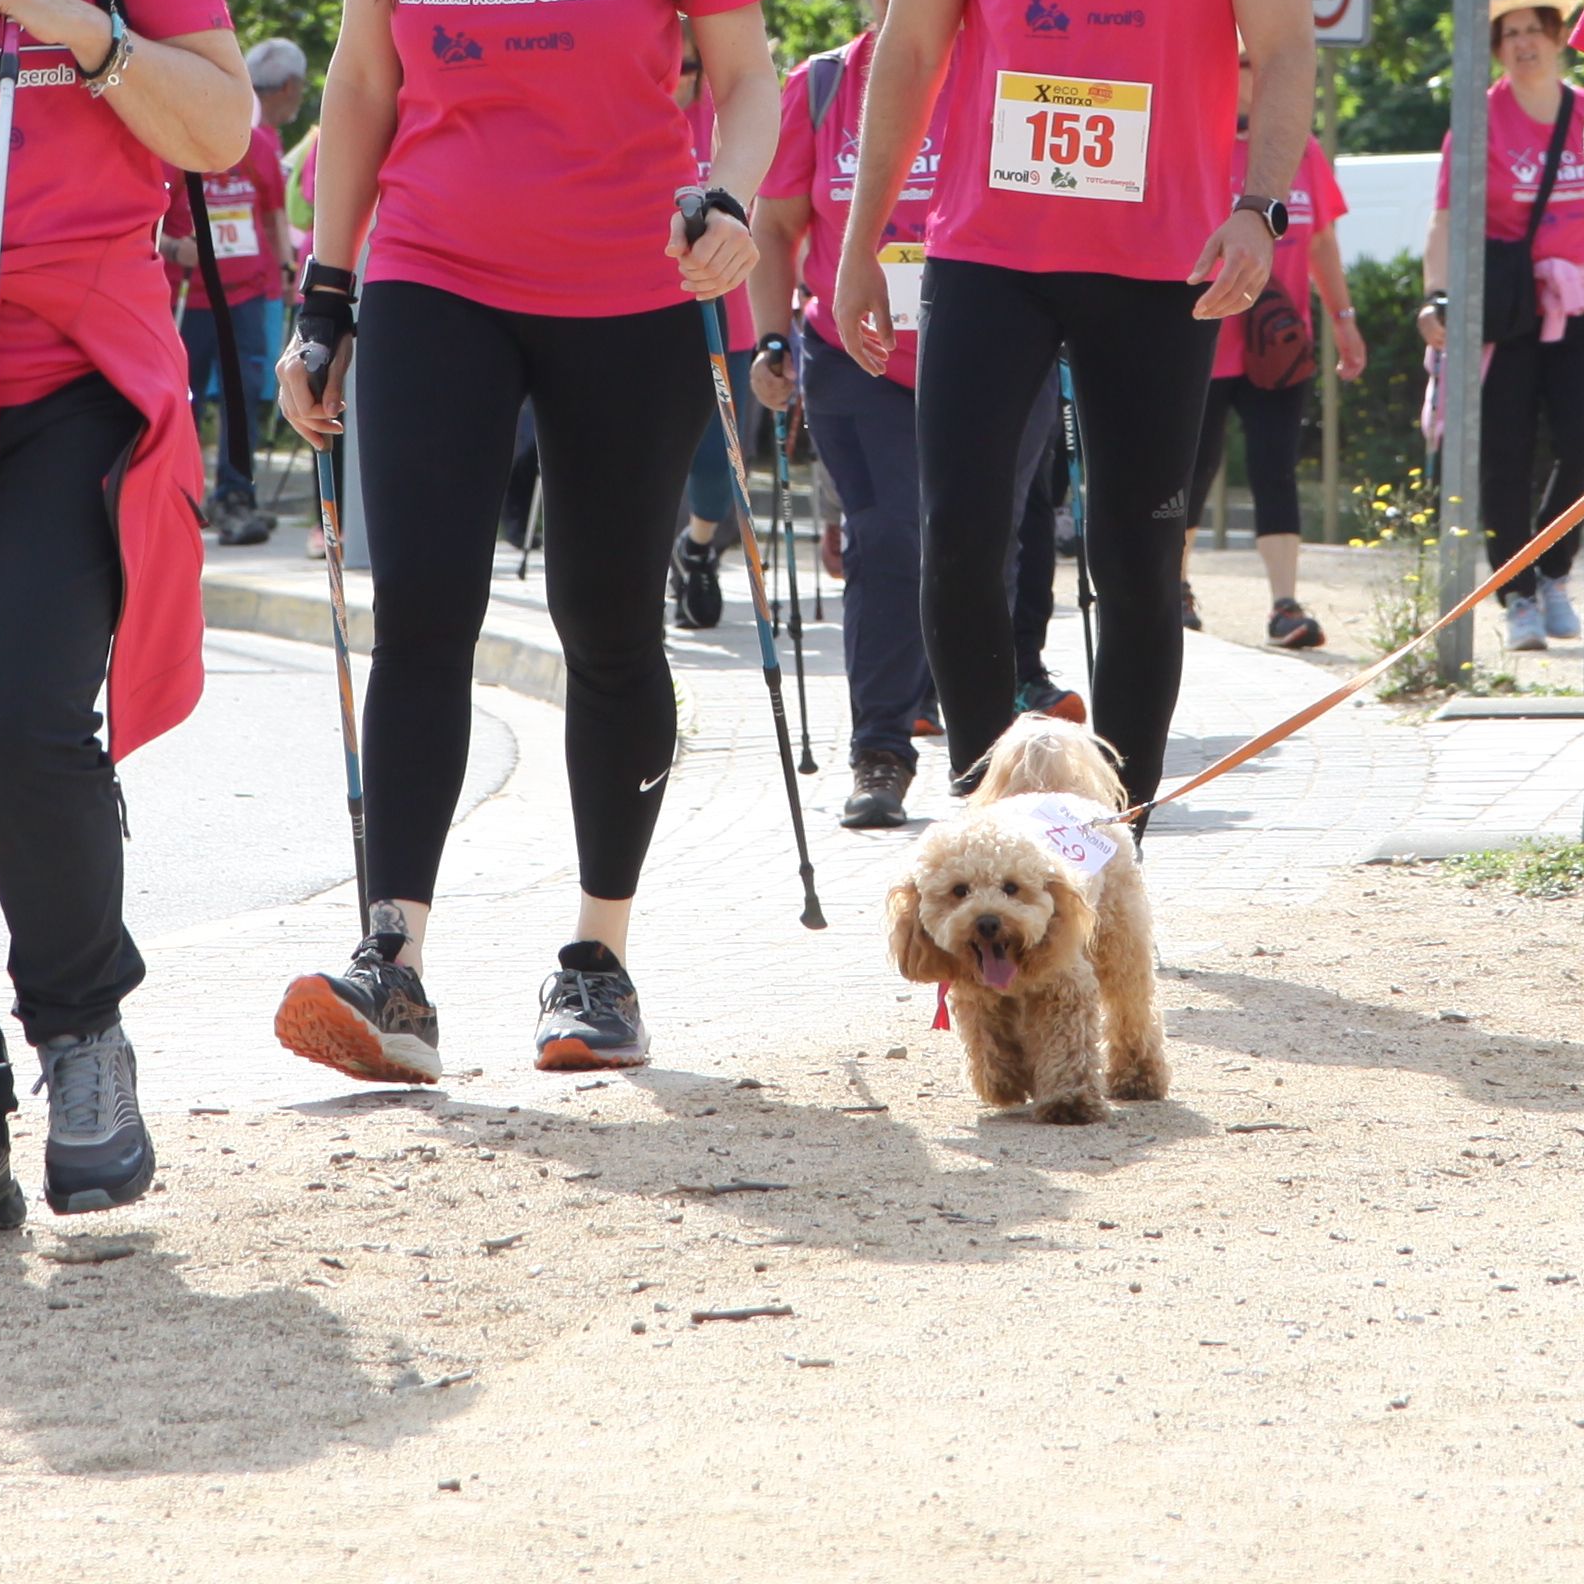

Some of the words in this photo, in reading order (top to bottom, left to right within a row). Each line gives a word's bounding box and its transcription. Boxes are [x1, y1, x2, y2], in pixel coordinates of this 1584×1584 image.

[1053, 85, 1079, 95] eco
[1052, 94, 1093, 107] marxa
[1026, 110, 1115, 168] 153
